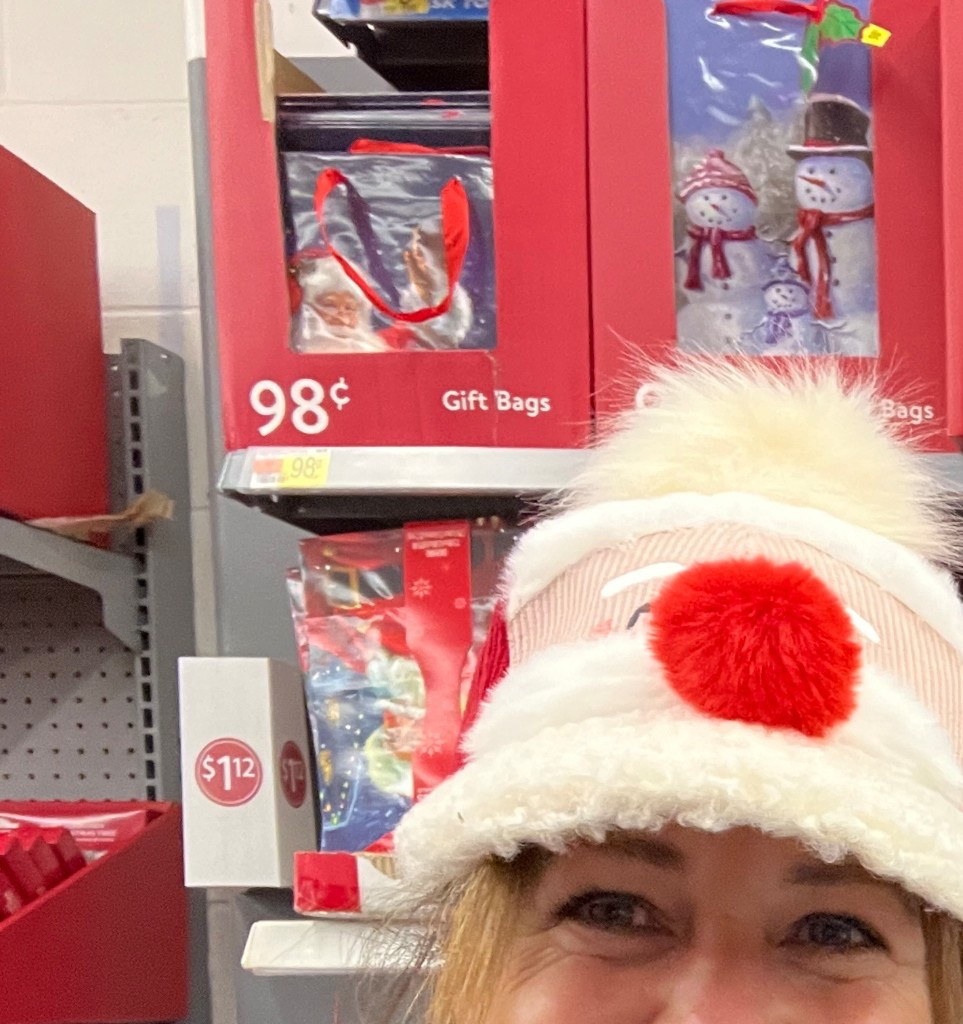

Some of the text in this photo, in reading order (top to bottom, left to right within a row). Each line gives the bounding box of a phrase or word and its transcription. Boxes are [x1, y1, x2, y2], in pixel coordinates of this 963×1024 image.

[250, 377, 350, 437] 98¢
[442, 389, 551, 418] Gift Bags
[882, 399, 935, 425] Bags
